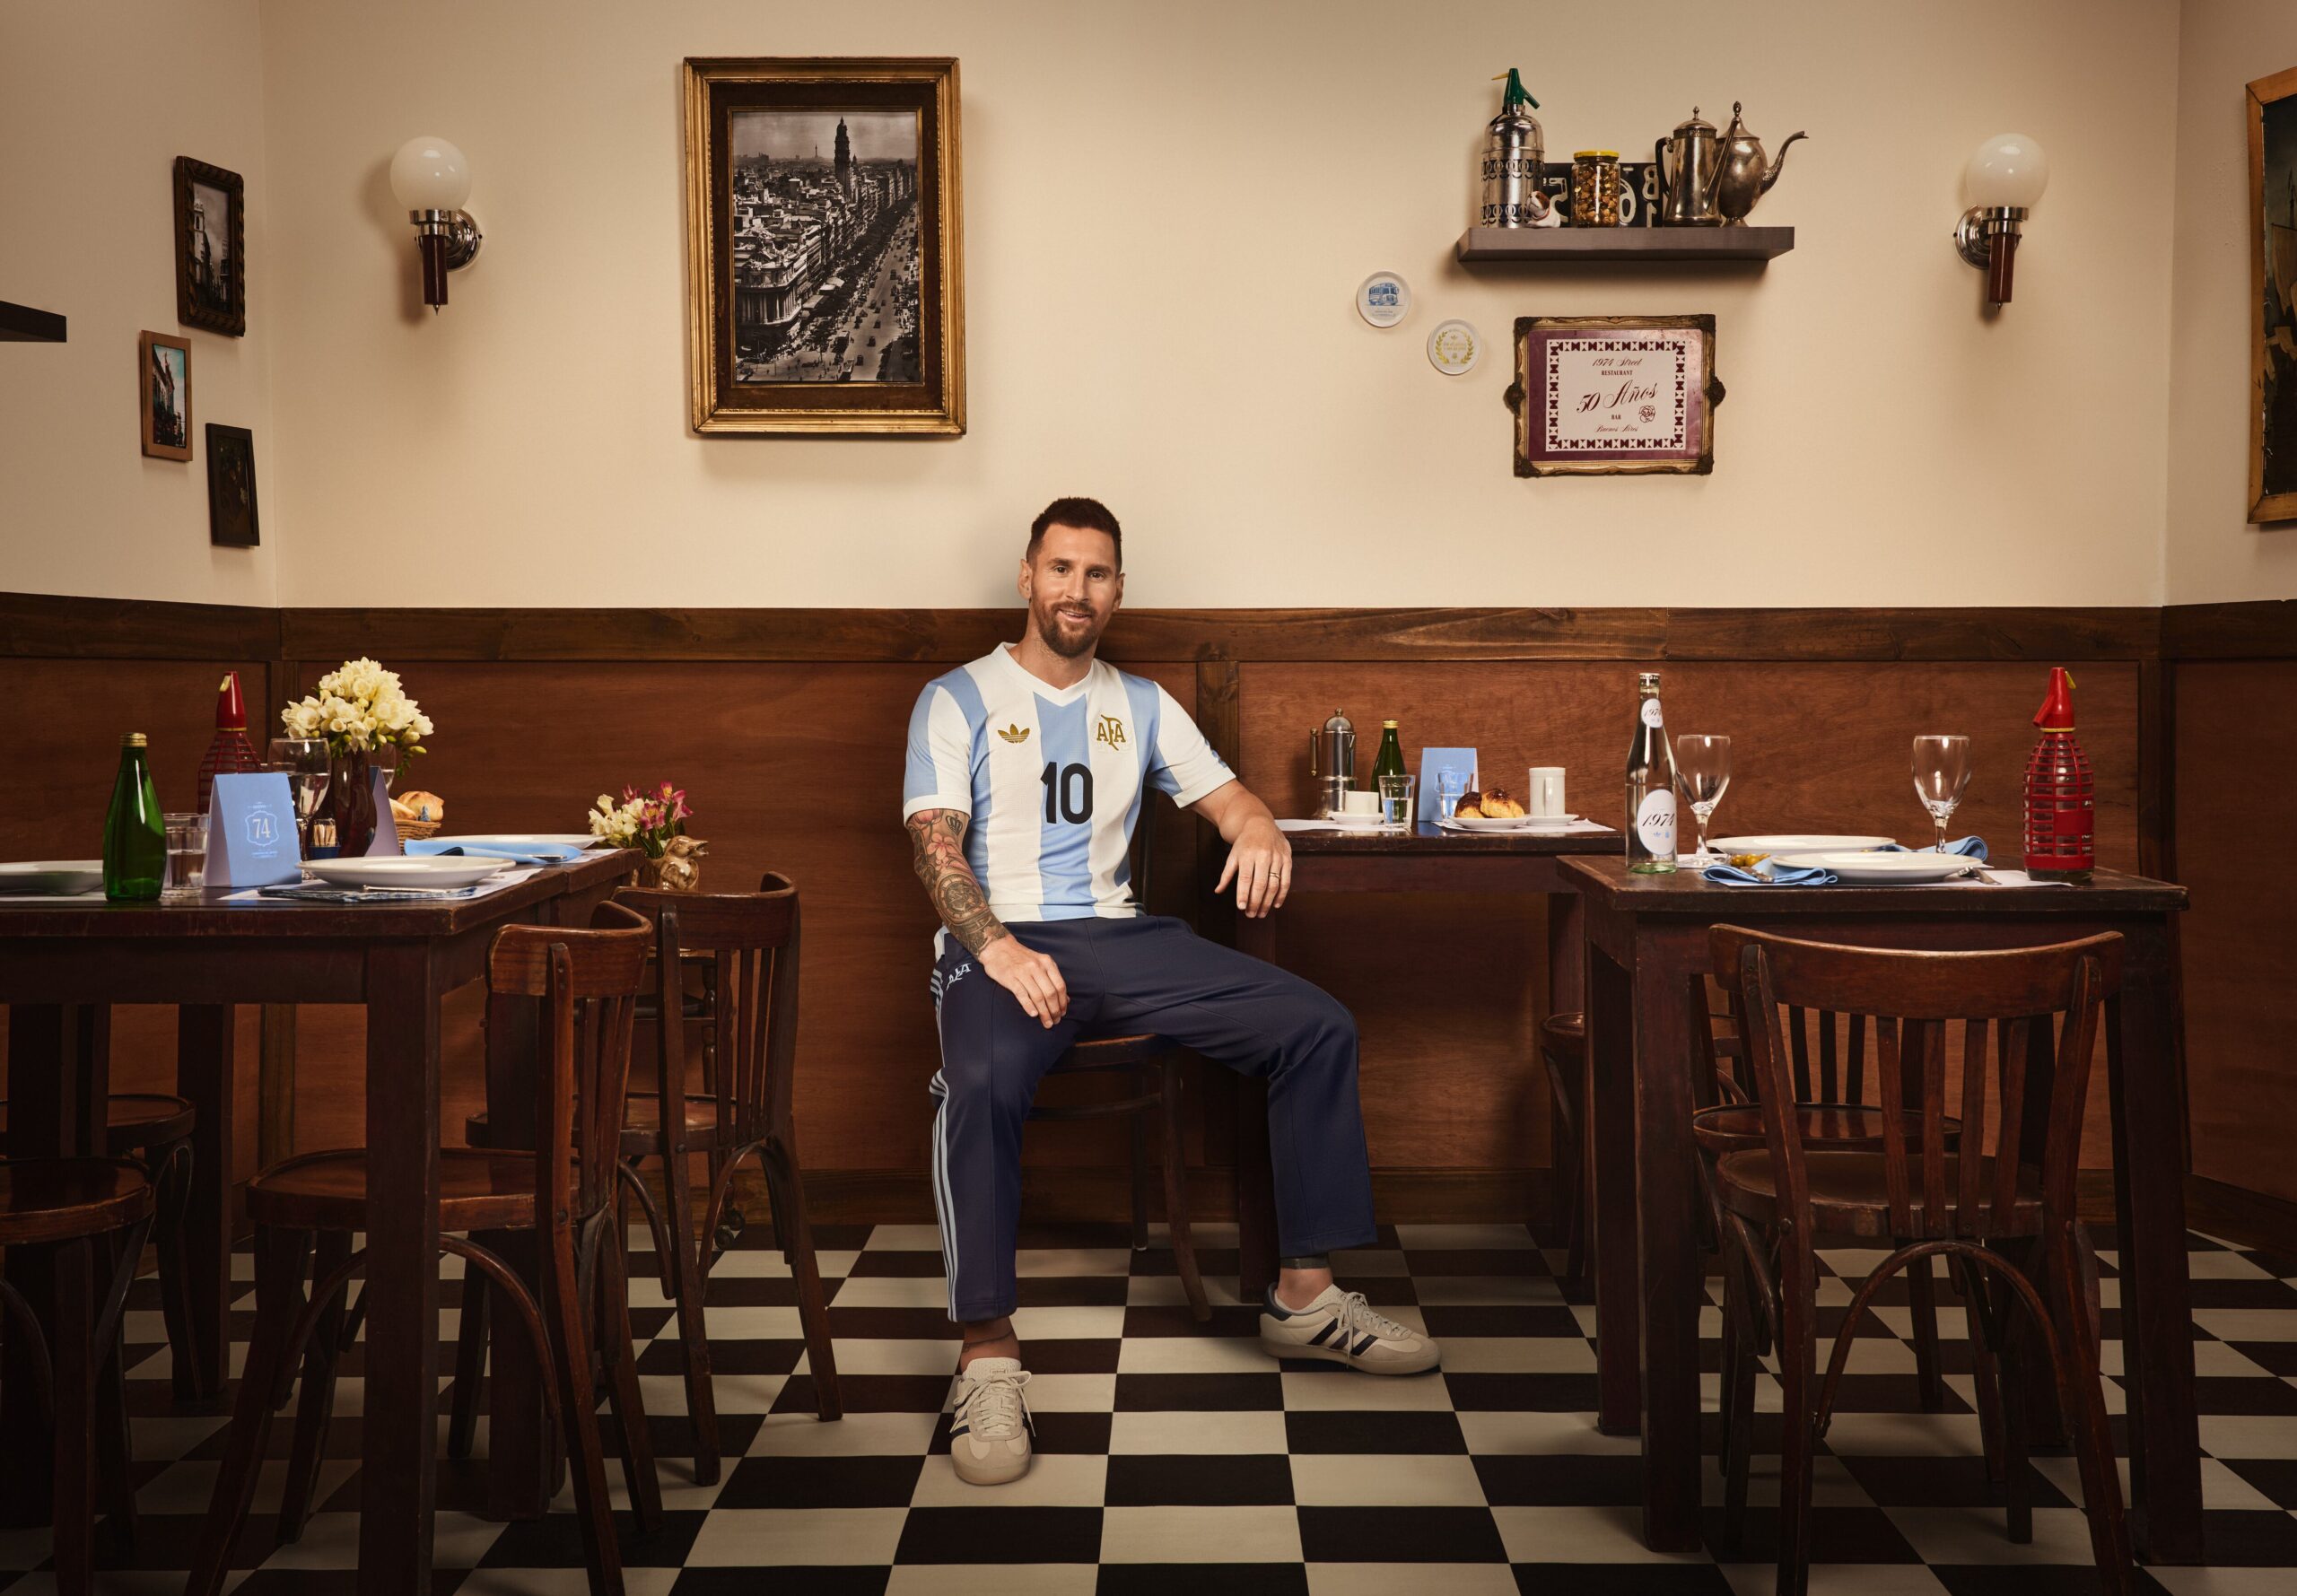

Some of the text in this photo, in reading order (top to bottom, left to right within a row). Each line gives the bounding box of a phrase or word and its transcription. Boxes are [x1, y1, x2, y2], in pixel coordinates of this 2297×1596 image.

[1592, 357, 1643, 367] 1974 Street
[1576, 379, 1658, 414] 50 Años
[1096, 714, 1126, 751] AFA
[1040, 762, 1093, 824] 10
[252, 817, 271, 839] 74
[1642, 813, 1675, 827] 1974
